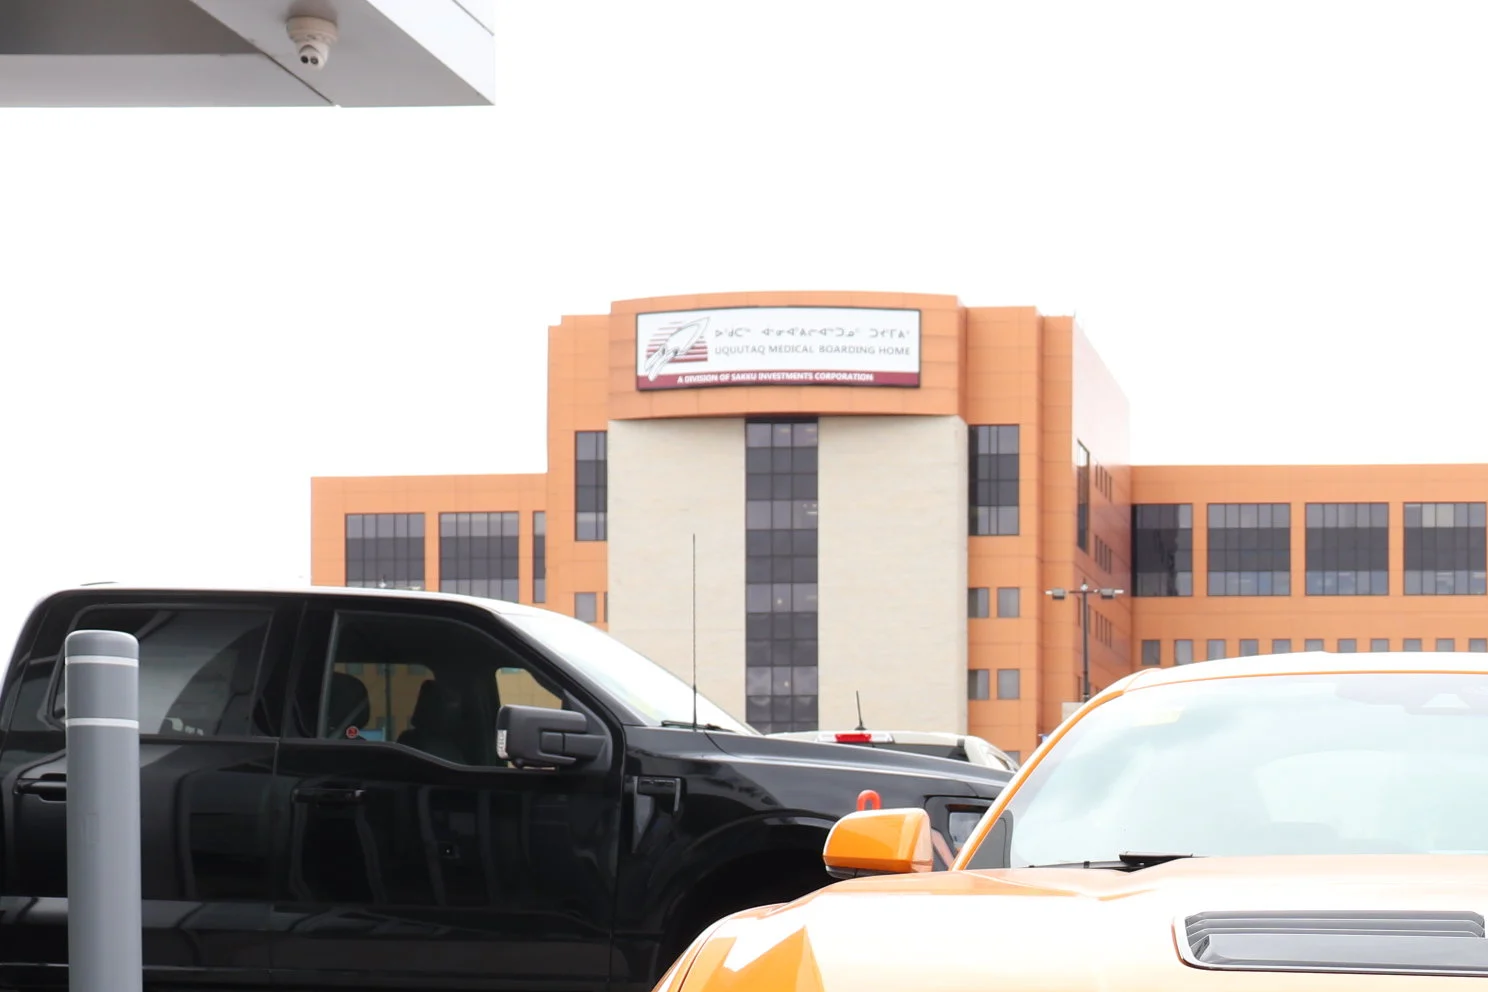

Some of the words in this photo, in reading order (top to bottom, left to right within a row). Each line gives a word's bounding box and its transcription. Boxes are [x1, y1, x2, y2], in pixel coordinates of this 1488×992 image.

[714, 345, 765, 356] UQUUTAQ
[768, 344, 814, 354] MEDICAL
[819, 344, 875, 355] BOARDING
[878, 346, 911, 356] HOME
[677, 376, 684, 384] A
[684, 374, 719, 383] DIVISION
[758, 372, 814, 380] INVESTMENTS
[814, 372, 874, 382] CORPORATION
